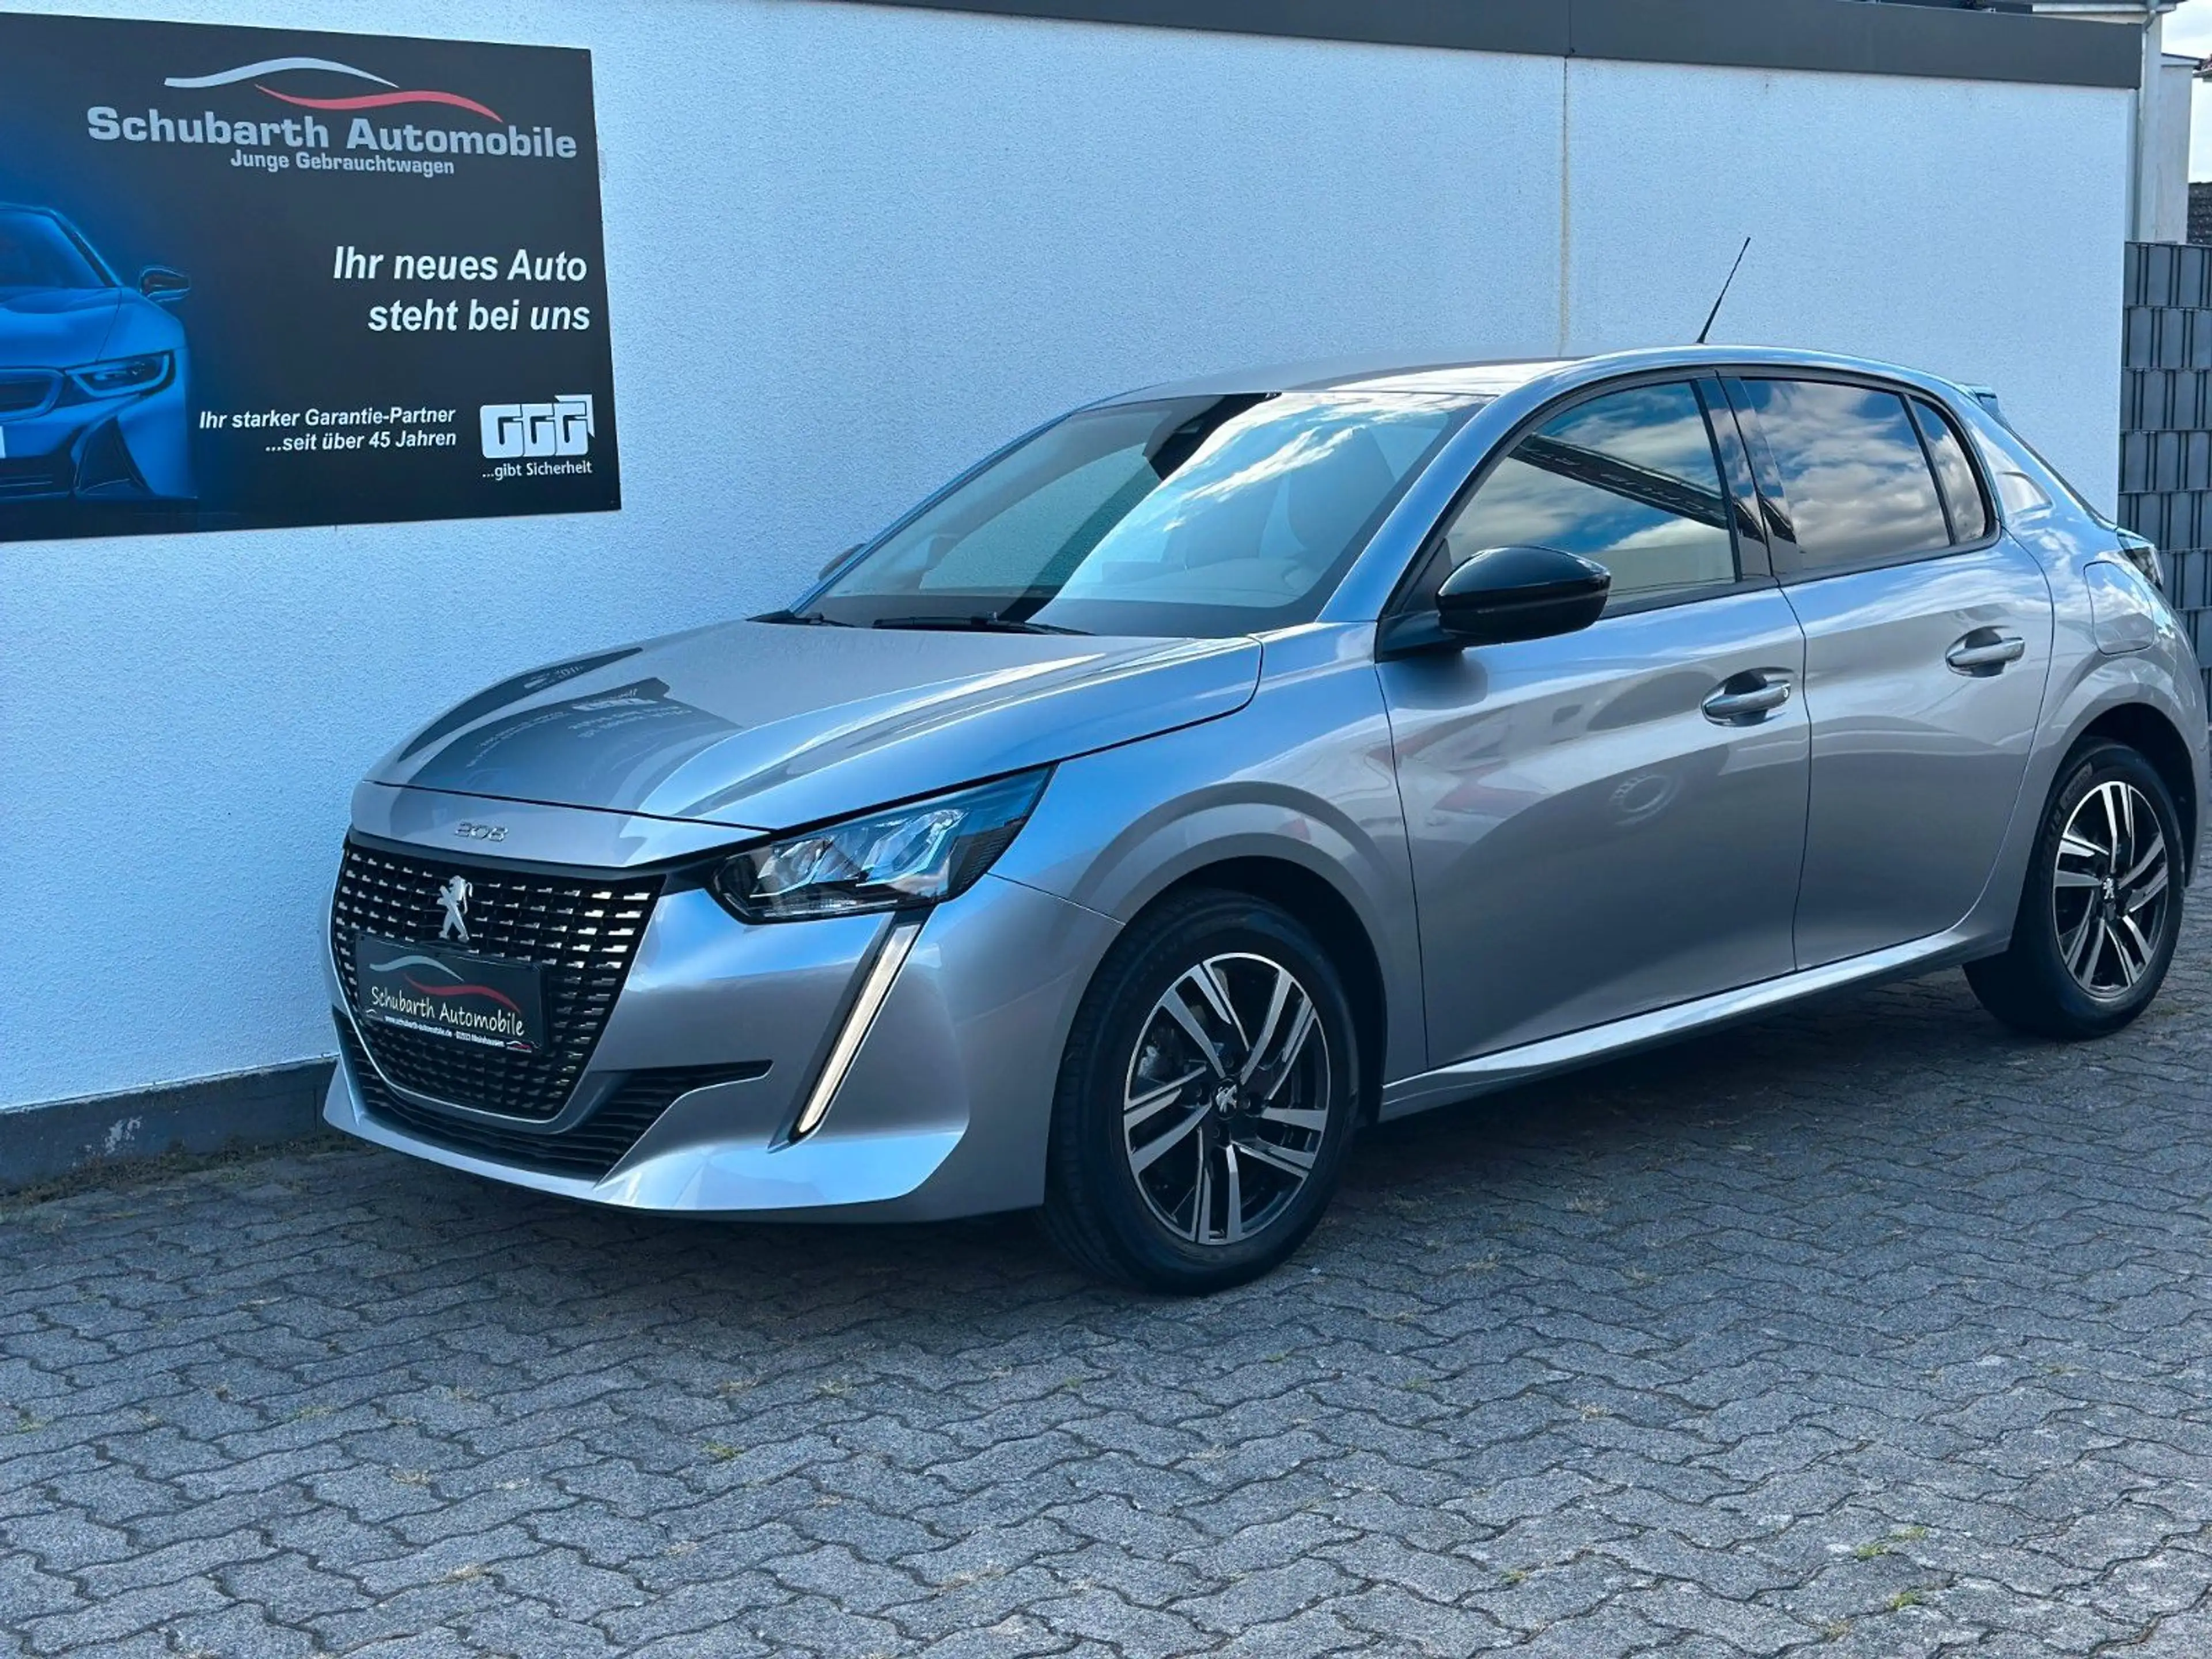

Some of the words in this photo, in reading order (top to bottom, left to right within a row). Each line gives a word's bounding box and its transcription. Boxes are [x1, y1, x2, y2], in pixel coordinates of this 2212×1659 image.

[87, 106, 329, 148] Schubarth
[346, 118, 577, 159] Automobile
[230, 149, 289, 173] Junge
[296, 151, 455, 177] Gebrauchtwagen
[333, 245, 384, 279] Ihr
[393, 253, 498, 281] neues
[507, 248, 588, 281] Auto
[368, 298, 459, 331] steht
[468, 298, 520, 331] bei
[529, 306, 591, 330] uns
[199, 411, 225, 429] Ihr
[232, 410, 301, 428] starker
[304, 406, 456, 426] Garantie-Partner
[480, 394, 594, 459] GGG
[265, 433, 318, 452] ...seit
[321, 432, 365, 450] über
[369, 431, 391, 448] 45
[395, 430, 457, 448] Jahren
[482, 463, 522, 480] ...gibt
[526, 460, 593, 476] Sicherheit
[454, 820, 509, 843] 208
[371, 986, 435, 1018] Schubarth
[439, 1002, 525, 1036] Automobile
